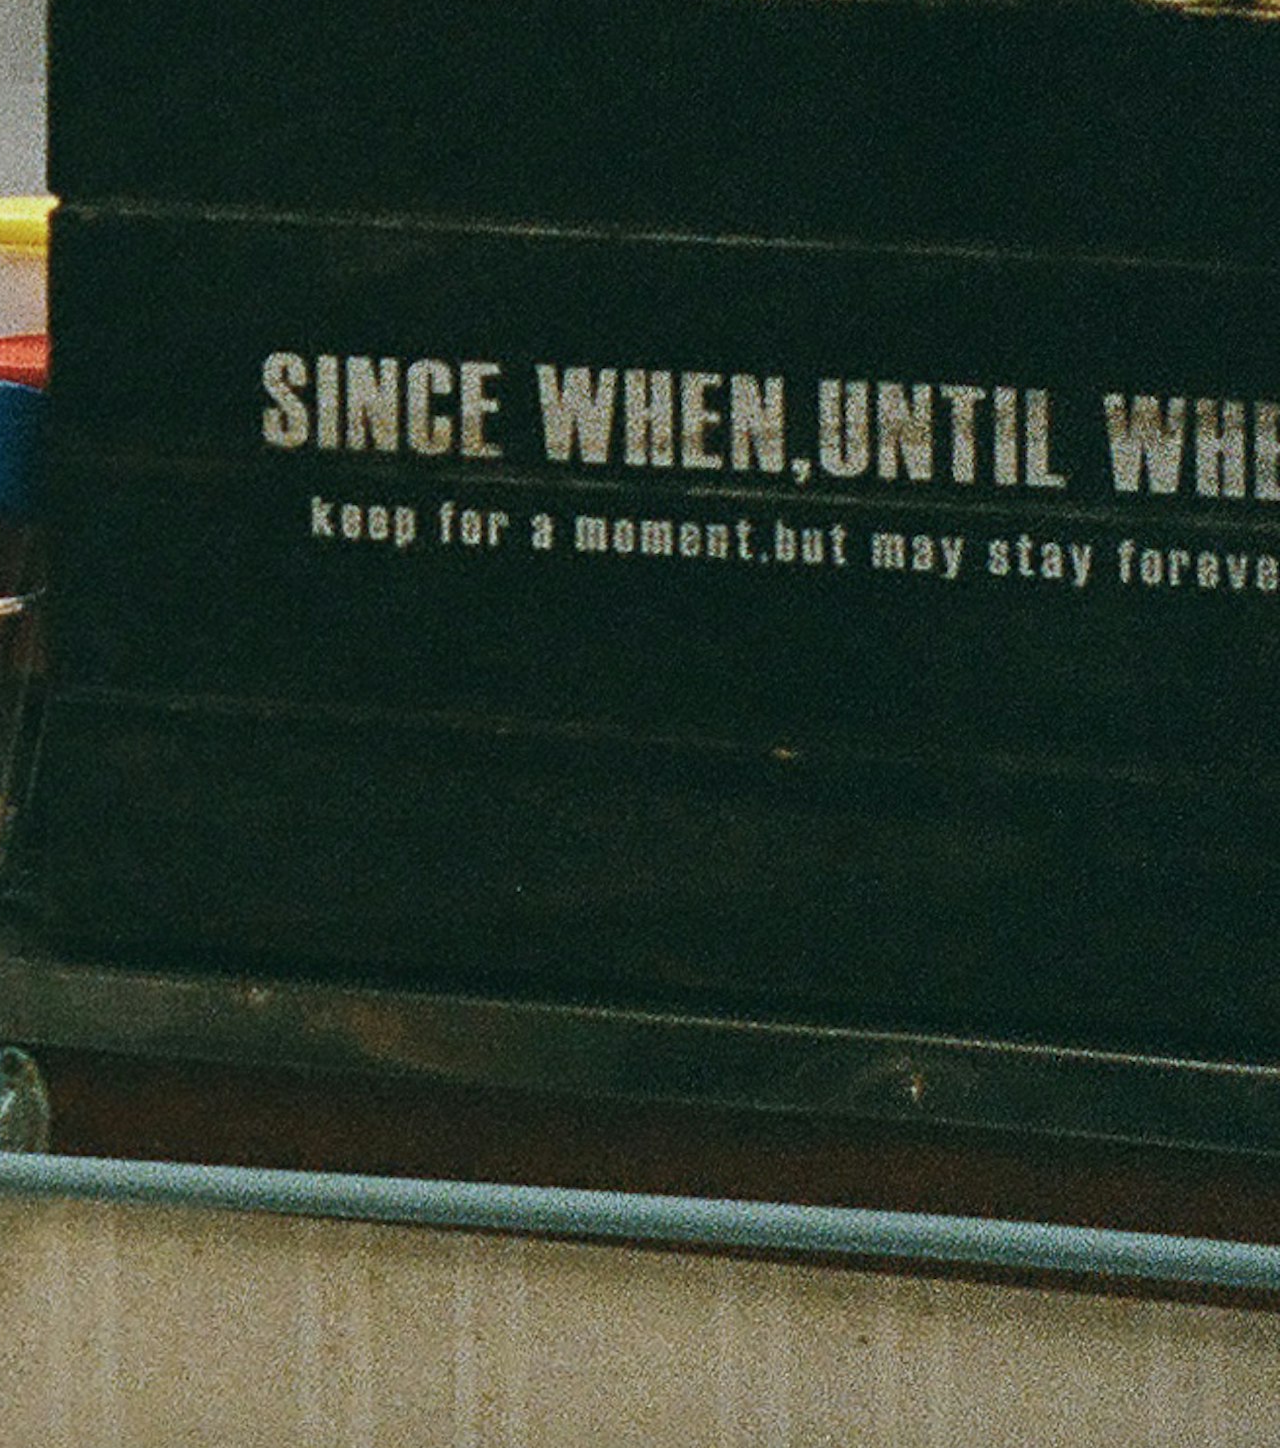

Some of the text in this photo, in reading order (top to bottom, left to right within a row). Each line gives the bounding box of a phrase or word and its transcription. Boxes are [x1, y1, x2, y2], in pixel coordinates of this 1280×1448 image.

[262, 351, 503, 458] SINCE
[312, 496, 416, 547] keep
[440, 501, 509, 546] for
[531, 513, 554, 550] a
[871, 532, 964, 580] may
[988, 534, 1092, 587] stay
